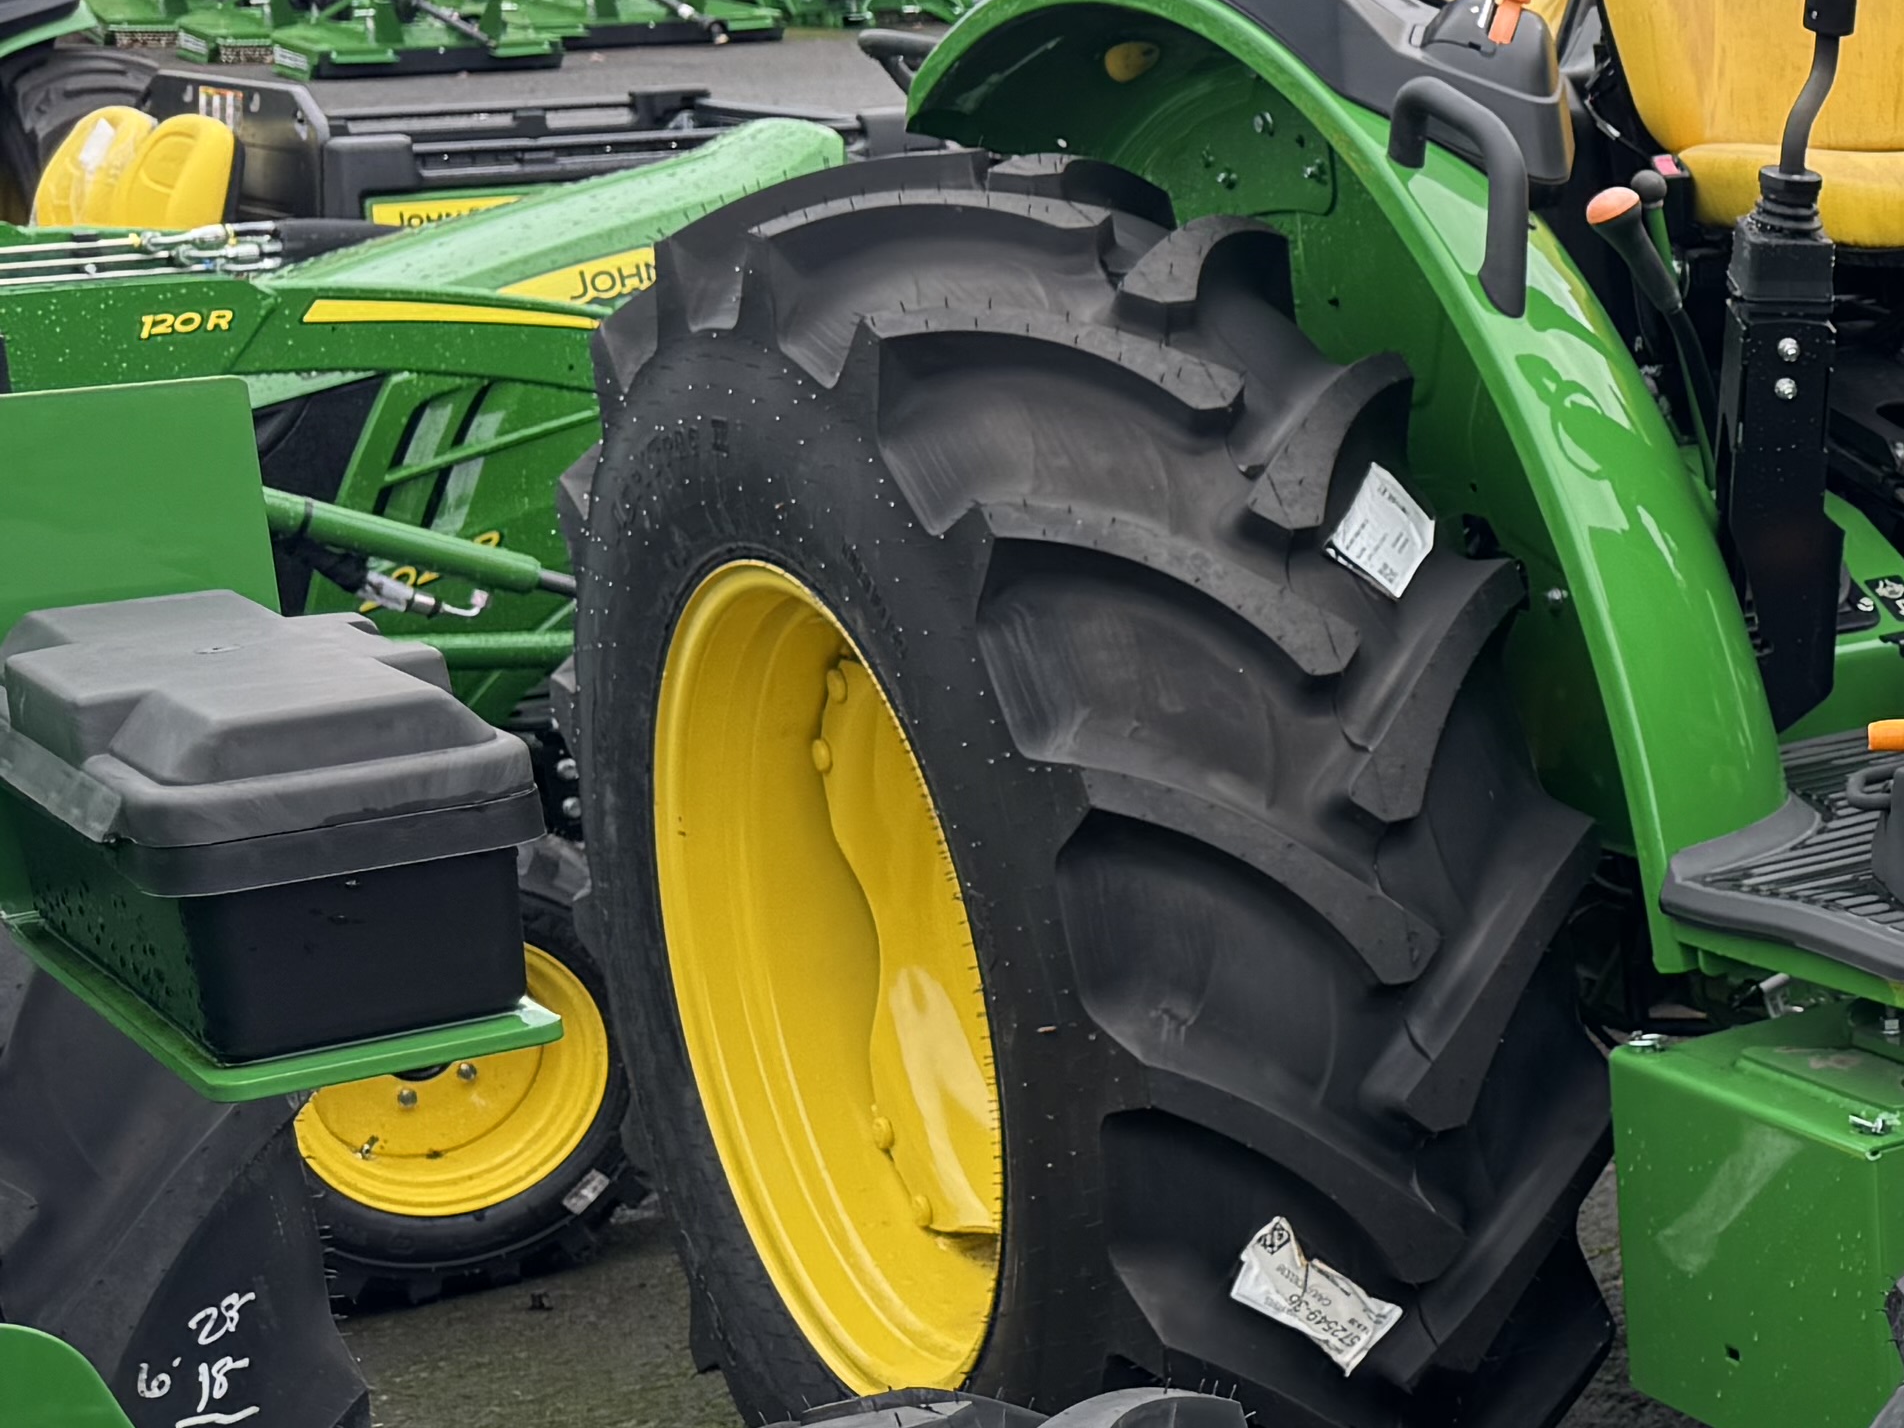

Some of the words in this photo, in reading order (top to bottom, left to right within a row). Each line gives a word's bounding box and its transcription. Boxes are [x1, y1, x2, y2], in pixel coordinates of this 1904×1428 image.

[139, 311, 202, 340] 120
[205, 309, 234, 331] R
[188, 1292, 256, 1346] 28
[196, 1355, 250, 1413] 18
